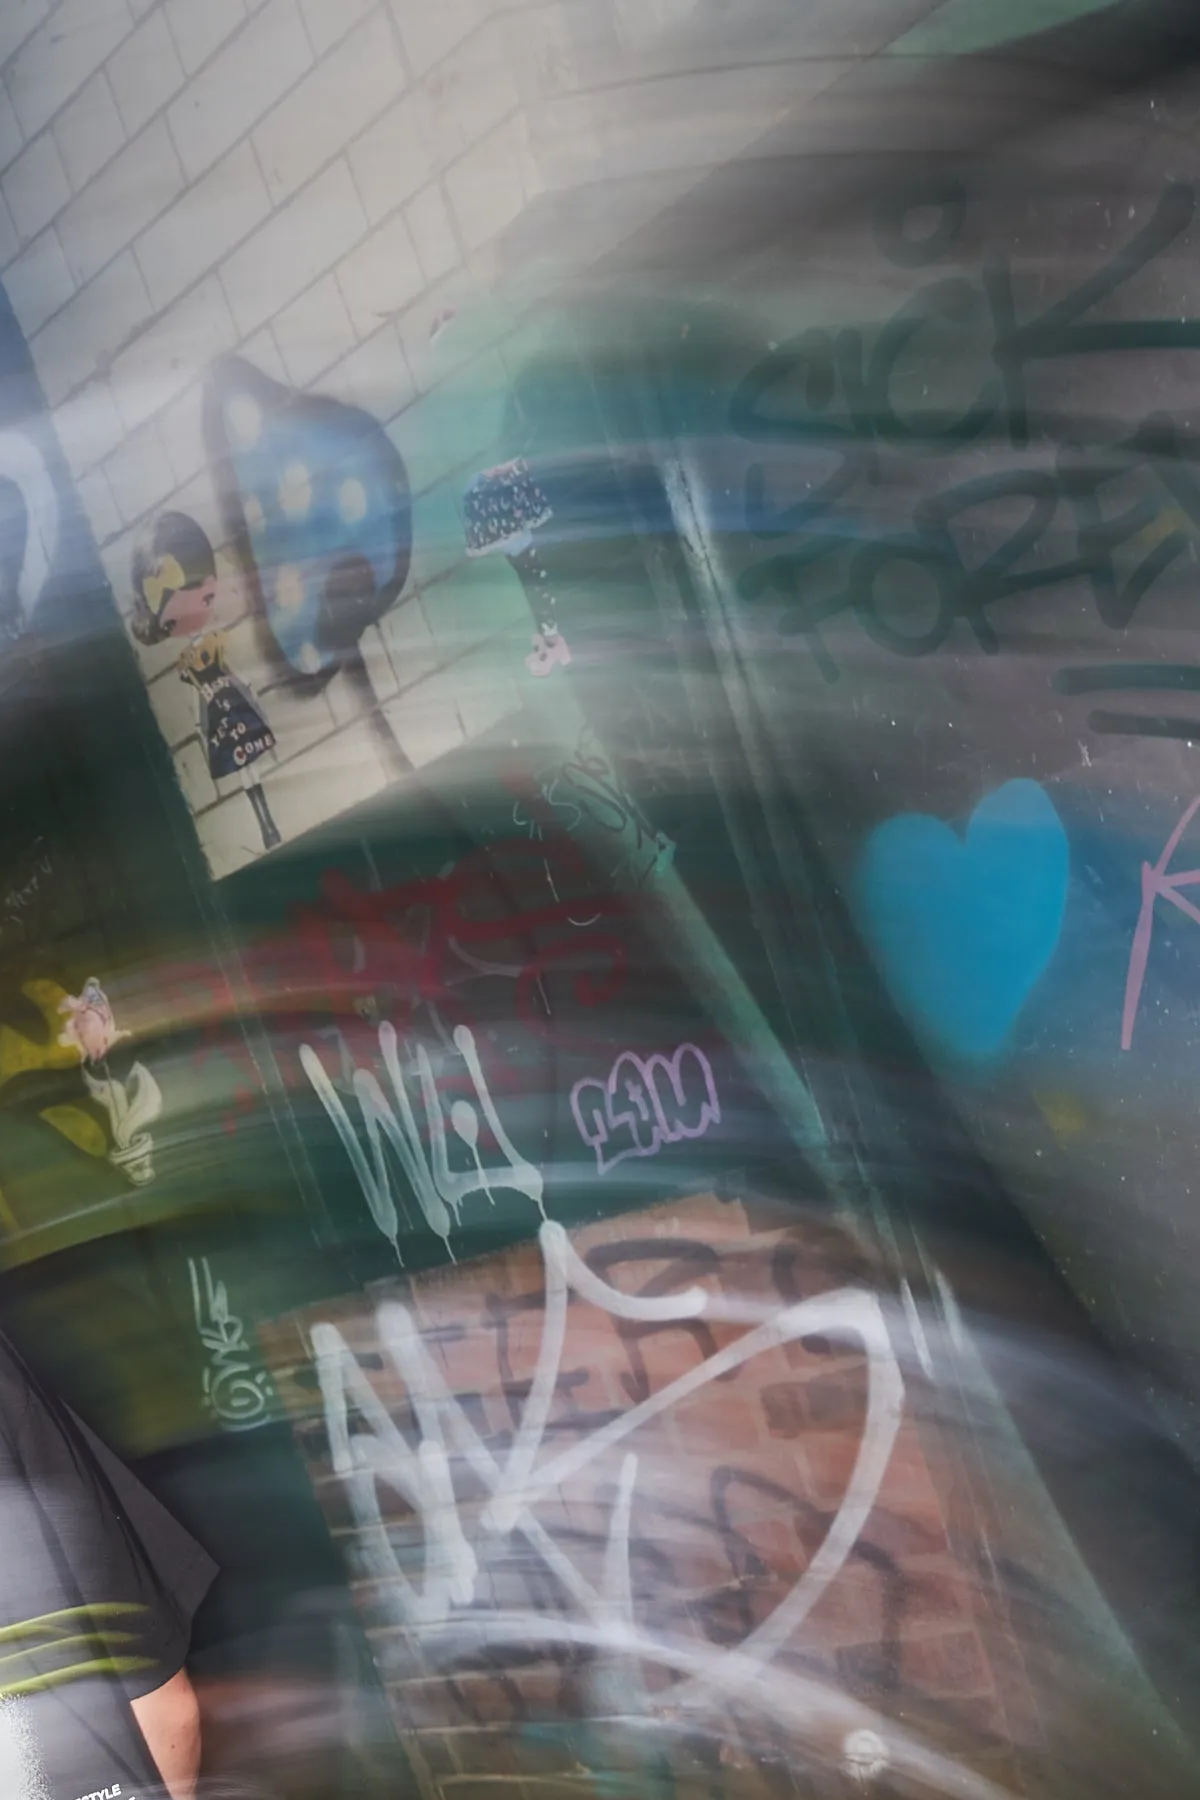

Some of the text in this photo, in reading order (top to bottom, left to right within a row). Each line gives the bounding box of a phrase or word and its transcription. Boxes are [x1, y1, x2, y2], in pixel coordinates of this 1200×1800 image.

[211, 718, 229, 747] YET
[230, 722, 246, 741] TO
[233, 734, 274, 766] COME
